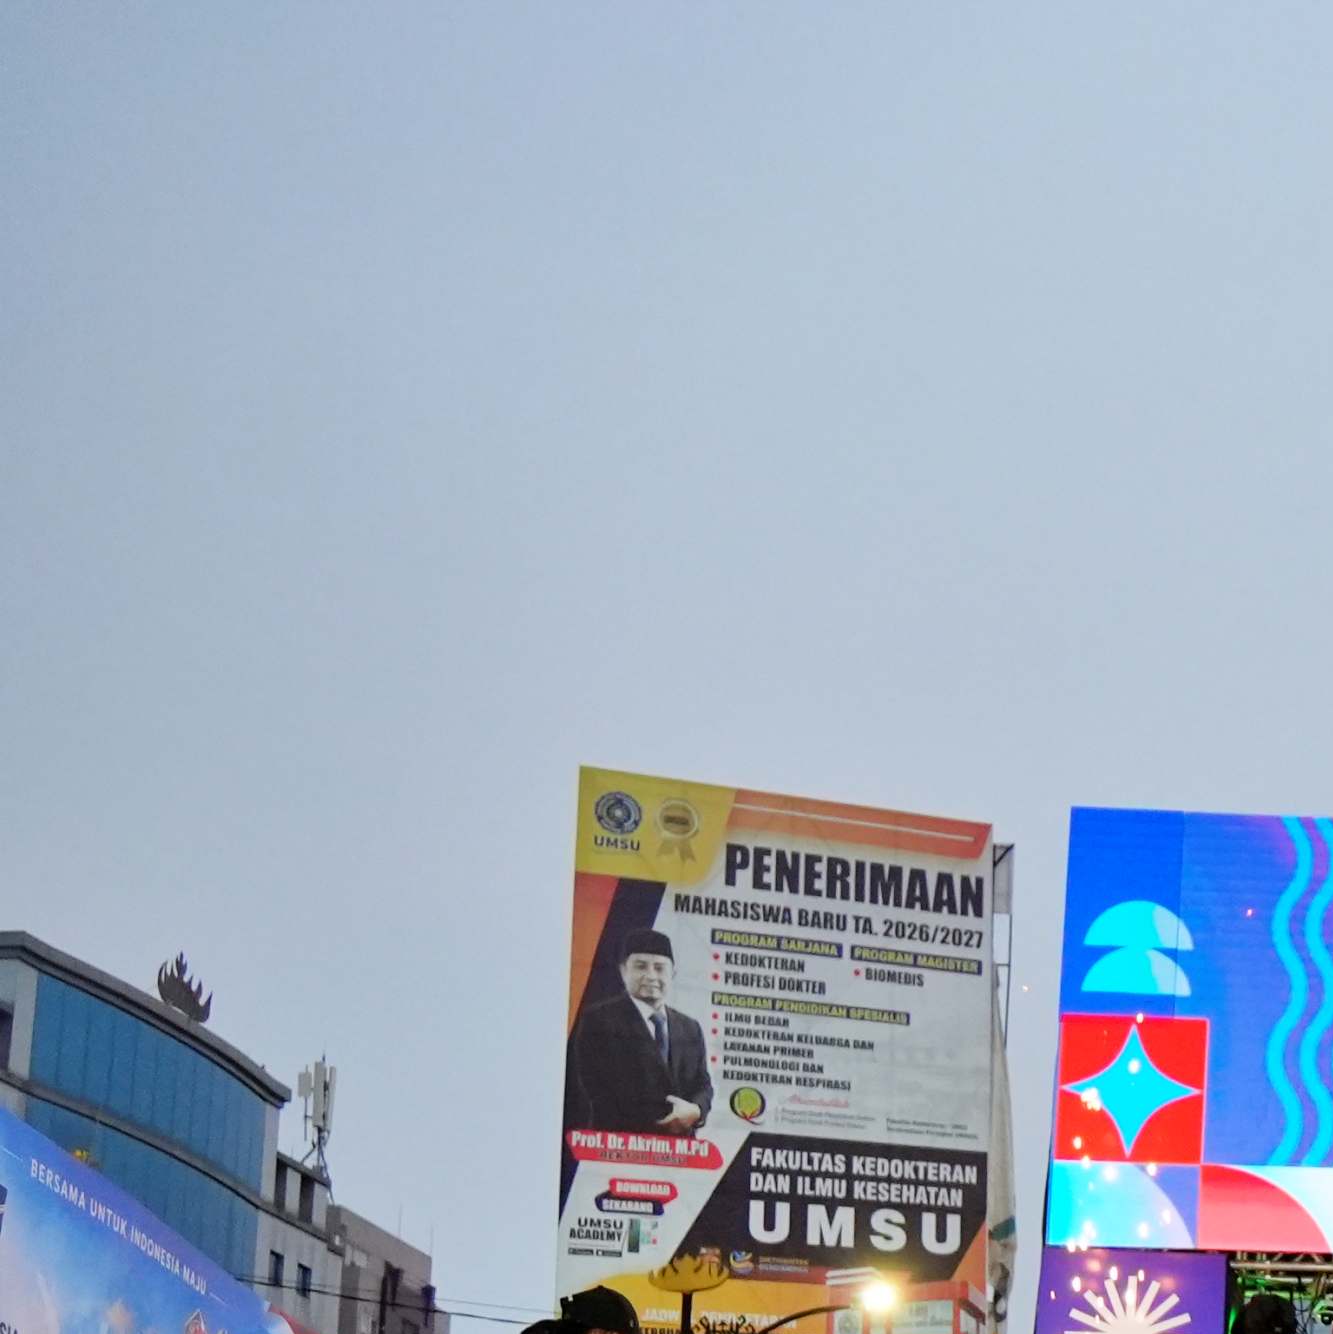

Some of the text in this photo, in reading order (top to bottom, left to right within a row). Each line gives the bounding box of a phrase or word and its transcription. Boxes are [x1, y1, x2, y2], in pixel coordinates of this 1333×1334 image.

[593, 835, 640, 851] UMSU
[724, 842, 984, 919] PENERIMAAN
[674, 893, 984, 949] MAHASISWA BARU TA. 2026/2027
[715, 931, 839, 957] PROGRAM SARJANA
[725, 951, 805, 973] KEDOKTERAN
[854, 947, 980, 975] PROGRAM MAGISTER
[724, 971, 827, 996] PROFESI DOKTER
[865, 968, 925, 987] BIOMEDIS
[713, 993, 772, 1010] PROGRAM
[775, 998, 847, 1018] PENDIDIKAN
[724, 1012, 790, 1028] ILMU BEDAH
[724, 1027, 875, 1051] KEDOKTERAN KELUARGA DAN
[773, 1046, 814, 1058] PRIMER
[723, 1055, 824, 1074] PULMONOLOGI DAN
[723, 1070, 851, 1091] KEDOKTERAN RESPIRASI
[571, 1131, 709, 1157] Prof. Dr. Akrim, M.Pd
[751, 1146, 977, 1184] FAKULTAS KEDOKTERAN
[616, 1181, 671, 1195] DOWNLOAD
[750, 1171, 963, 1208] DAN ILMU KESEHATAN
[30, 1157, 207, 1296] BERSAMA UNTUK INDONESIA MAJU
[569, 1228, 622, 1242] ACADEMY
[577, 1217, 624, 1230] UMSU
[749, 1200, 963, 1256] UMSU
